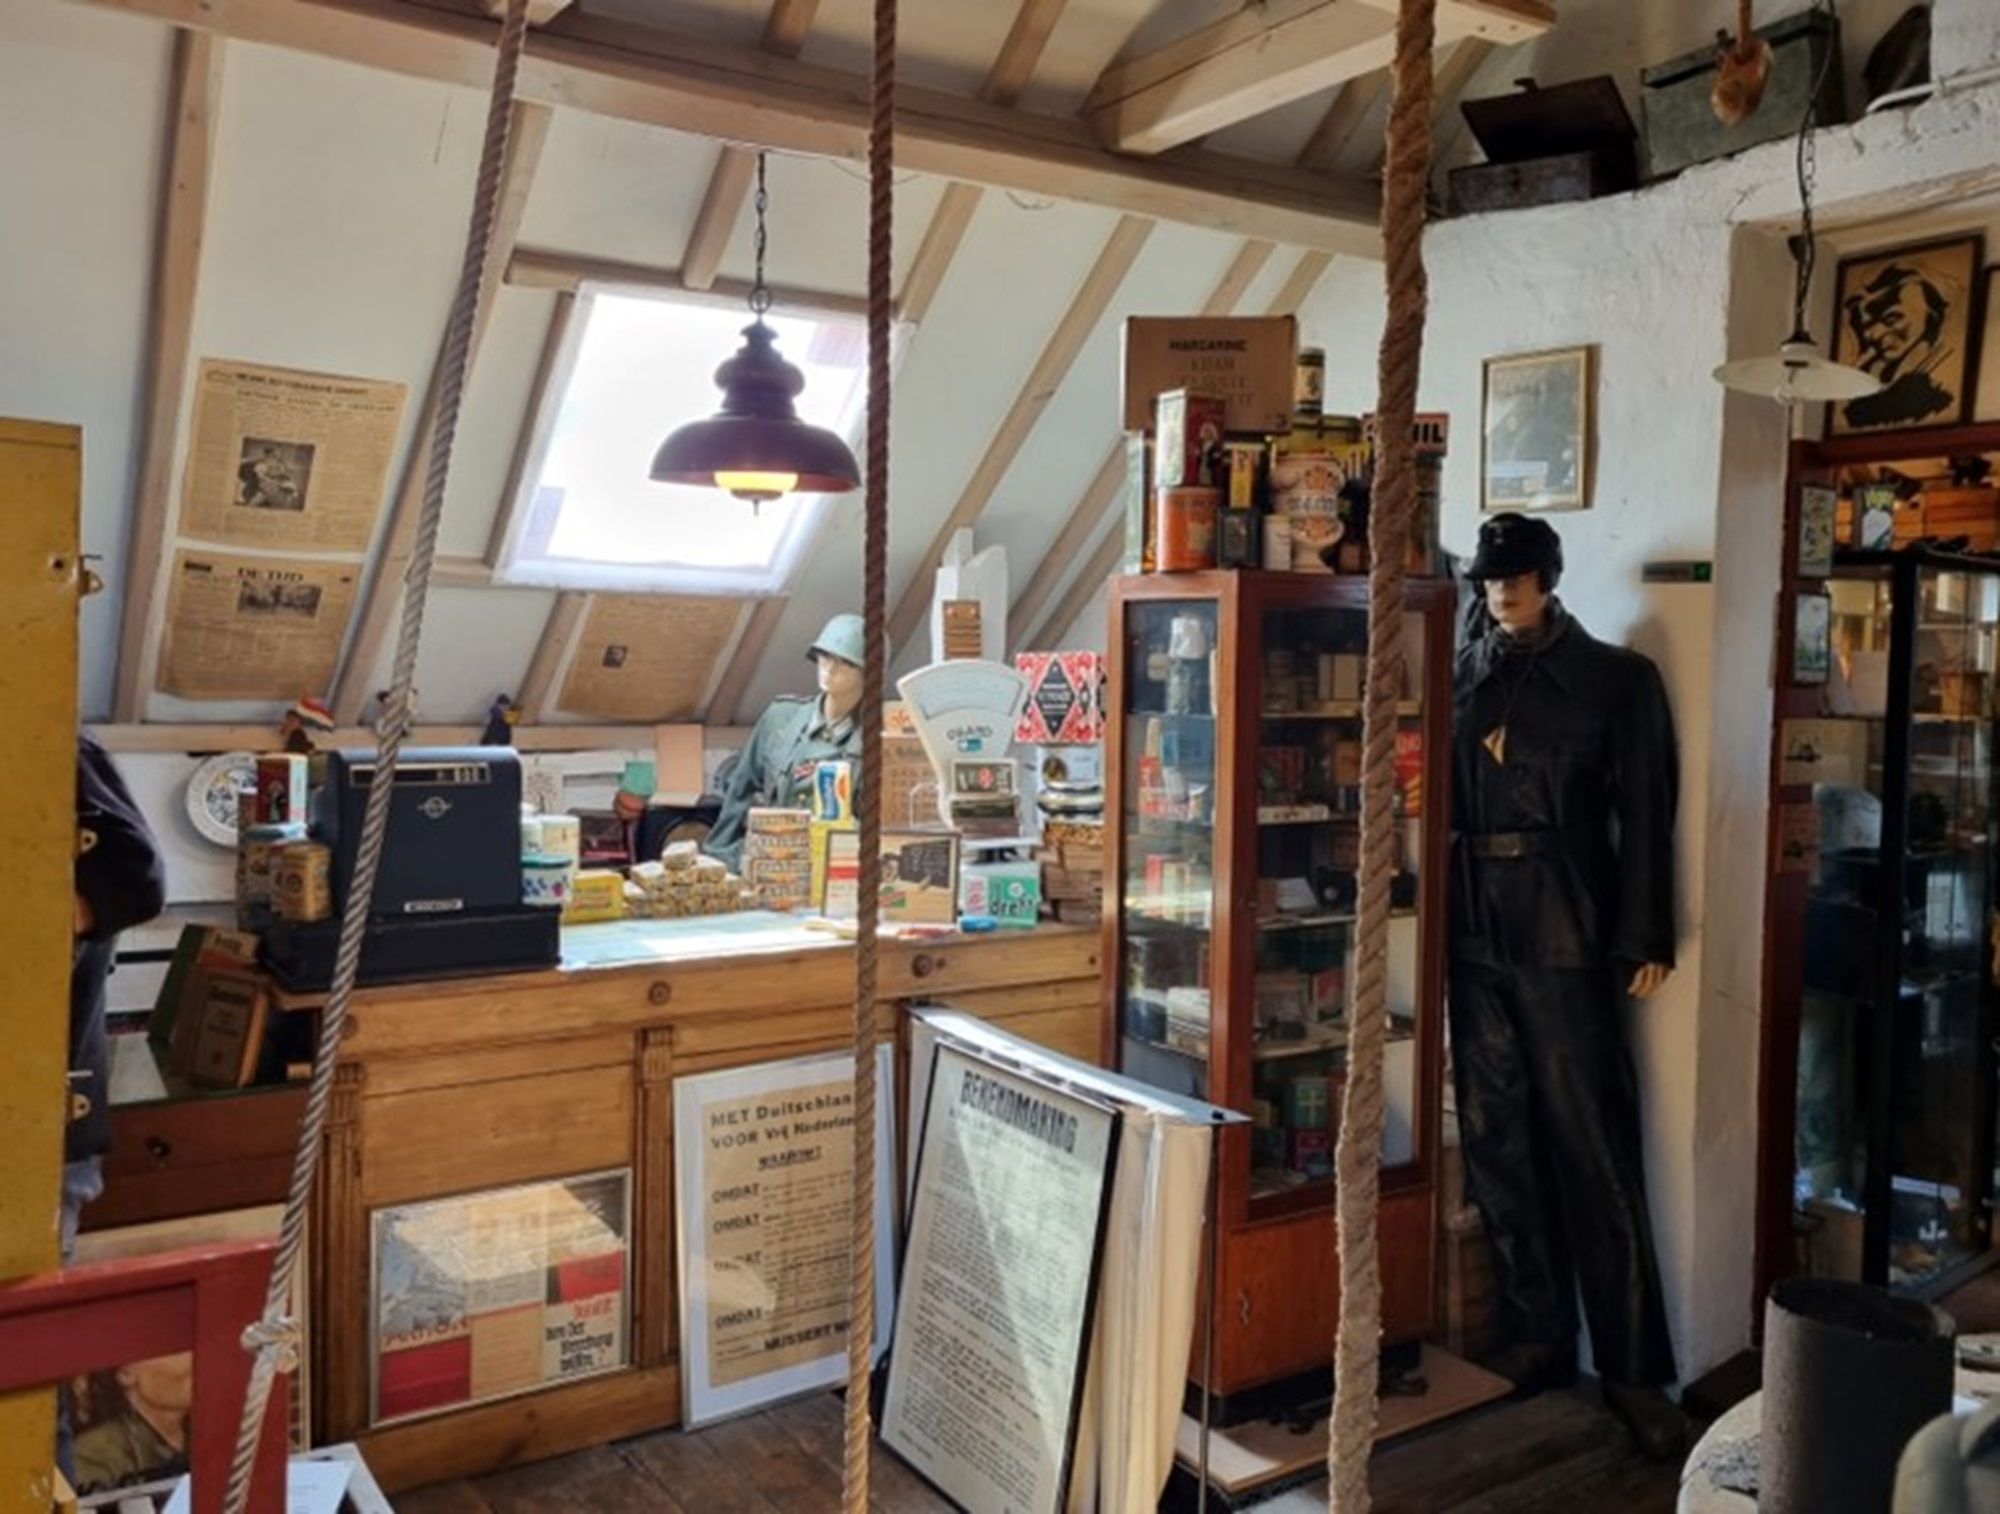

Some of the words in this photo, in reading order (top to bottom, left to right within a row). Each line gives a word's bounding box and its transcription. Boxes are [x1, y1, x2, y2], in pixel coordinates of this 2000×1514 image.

[711, 1108, 749, 1127] MET
[756, 1094, 851, 1120] Duitschlan
[711, 1131, 758, 1148] VOOR
[794, 1116, 855, 1134] Nederlan
[712, 1183, 760, 1203] OMDAT
[713, 1214, 760, 1233] OMDAT
[715, 1308, 762, 1329] OMDAT
